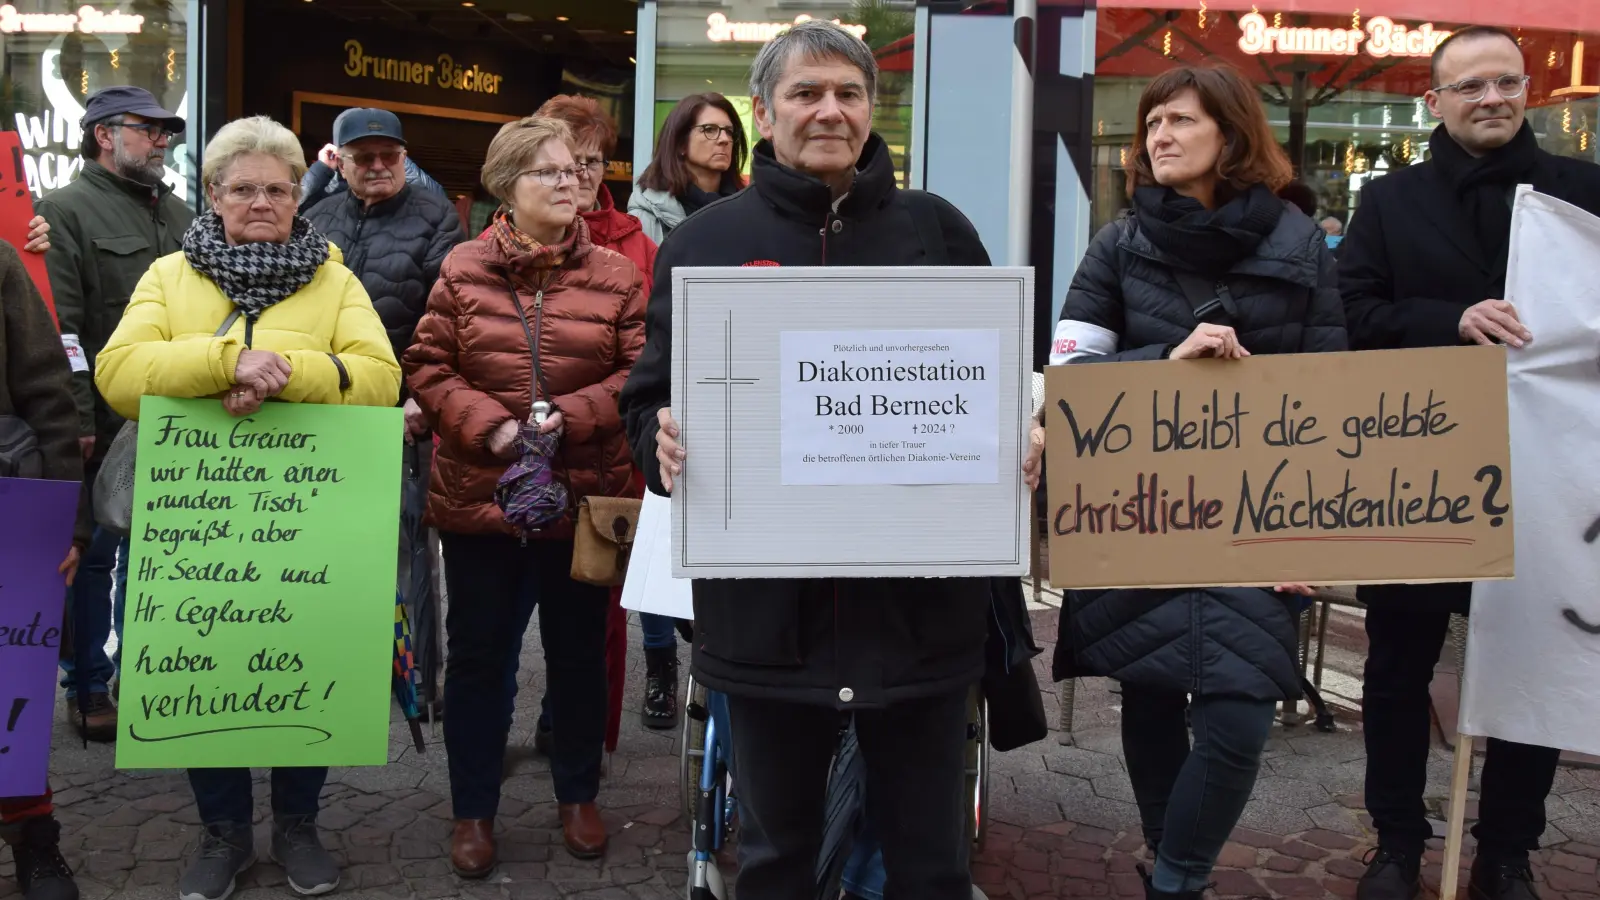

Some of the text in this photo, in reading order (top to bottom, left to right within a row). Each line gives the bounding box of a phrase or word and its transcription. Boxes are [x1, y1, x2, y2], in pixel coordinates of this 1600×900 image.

[1239, 13, 1364, 54] Brunner
[344, 39, 503, 95] Brunner Bäcker
[834, 344, 866, 352] Plötzlich
[886, 344, 949, 353] unvorhergesehen
[797, 359, 986, 382] Diakoniestation
[815, 393, 969, 416] Bad Berneck
[155, 416, 316, 452] Frau Greiner,
[838, 425, 863, 434] 2000
[1058, 390, 1458, 458] Wo bleibt die gelebte
[151, 457, 345, 484] wir hätten einen
[803, 453, 980, 462] die betroffenen örtlichen Diakonie-Vereine
[1054, 456, 1509, 536] christliche Nächstenliebe?
[252, 520, 303, 542] aber
[281, 565, 331, 584] und
[134, 593, 292, 637] Hr. Ceglarek
[135, 645, 303, 674] haben dies
